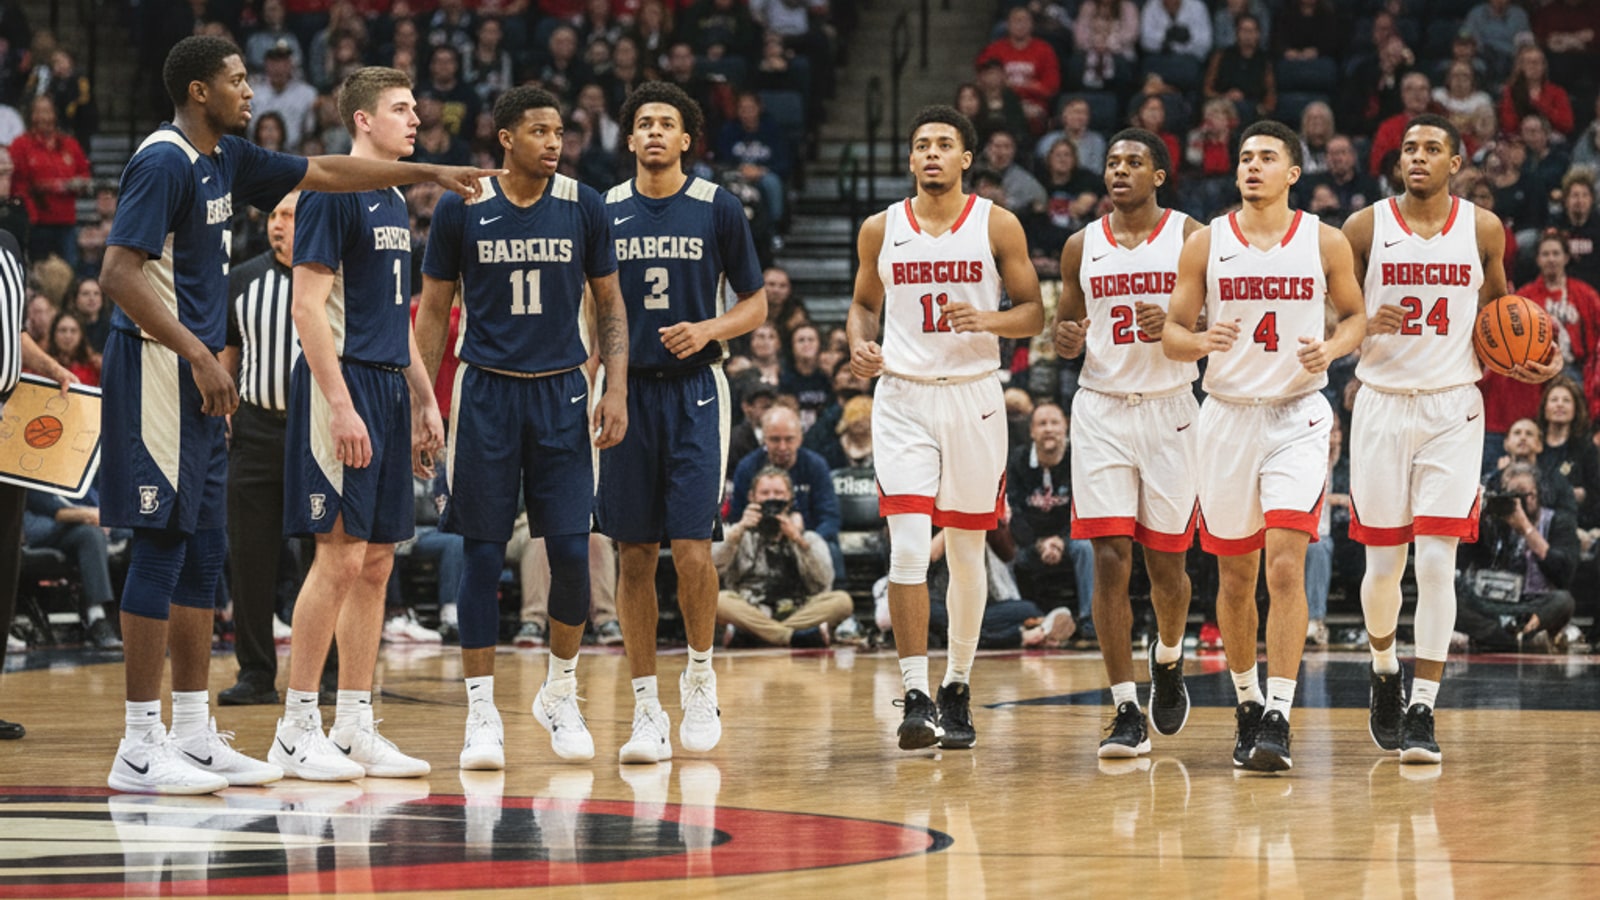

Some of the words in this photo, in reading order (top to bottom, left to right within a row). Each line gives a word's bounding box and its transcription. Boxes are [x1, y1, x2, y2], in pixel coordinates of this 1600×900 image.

[393, 259, 402, 305] 1
[510, 269, 542, 315] 11
[1253, 311, 1279, 352] 4
[1400, 296, 1450, 336] 24
